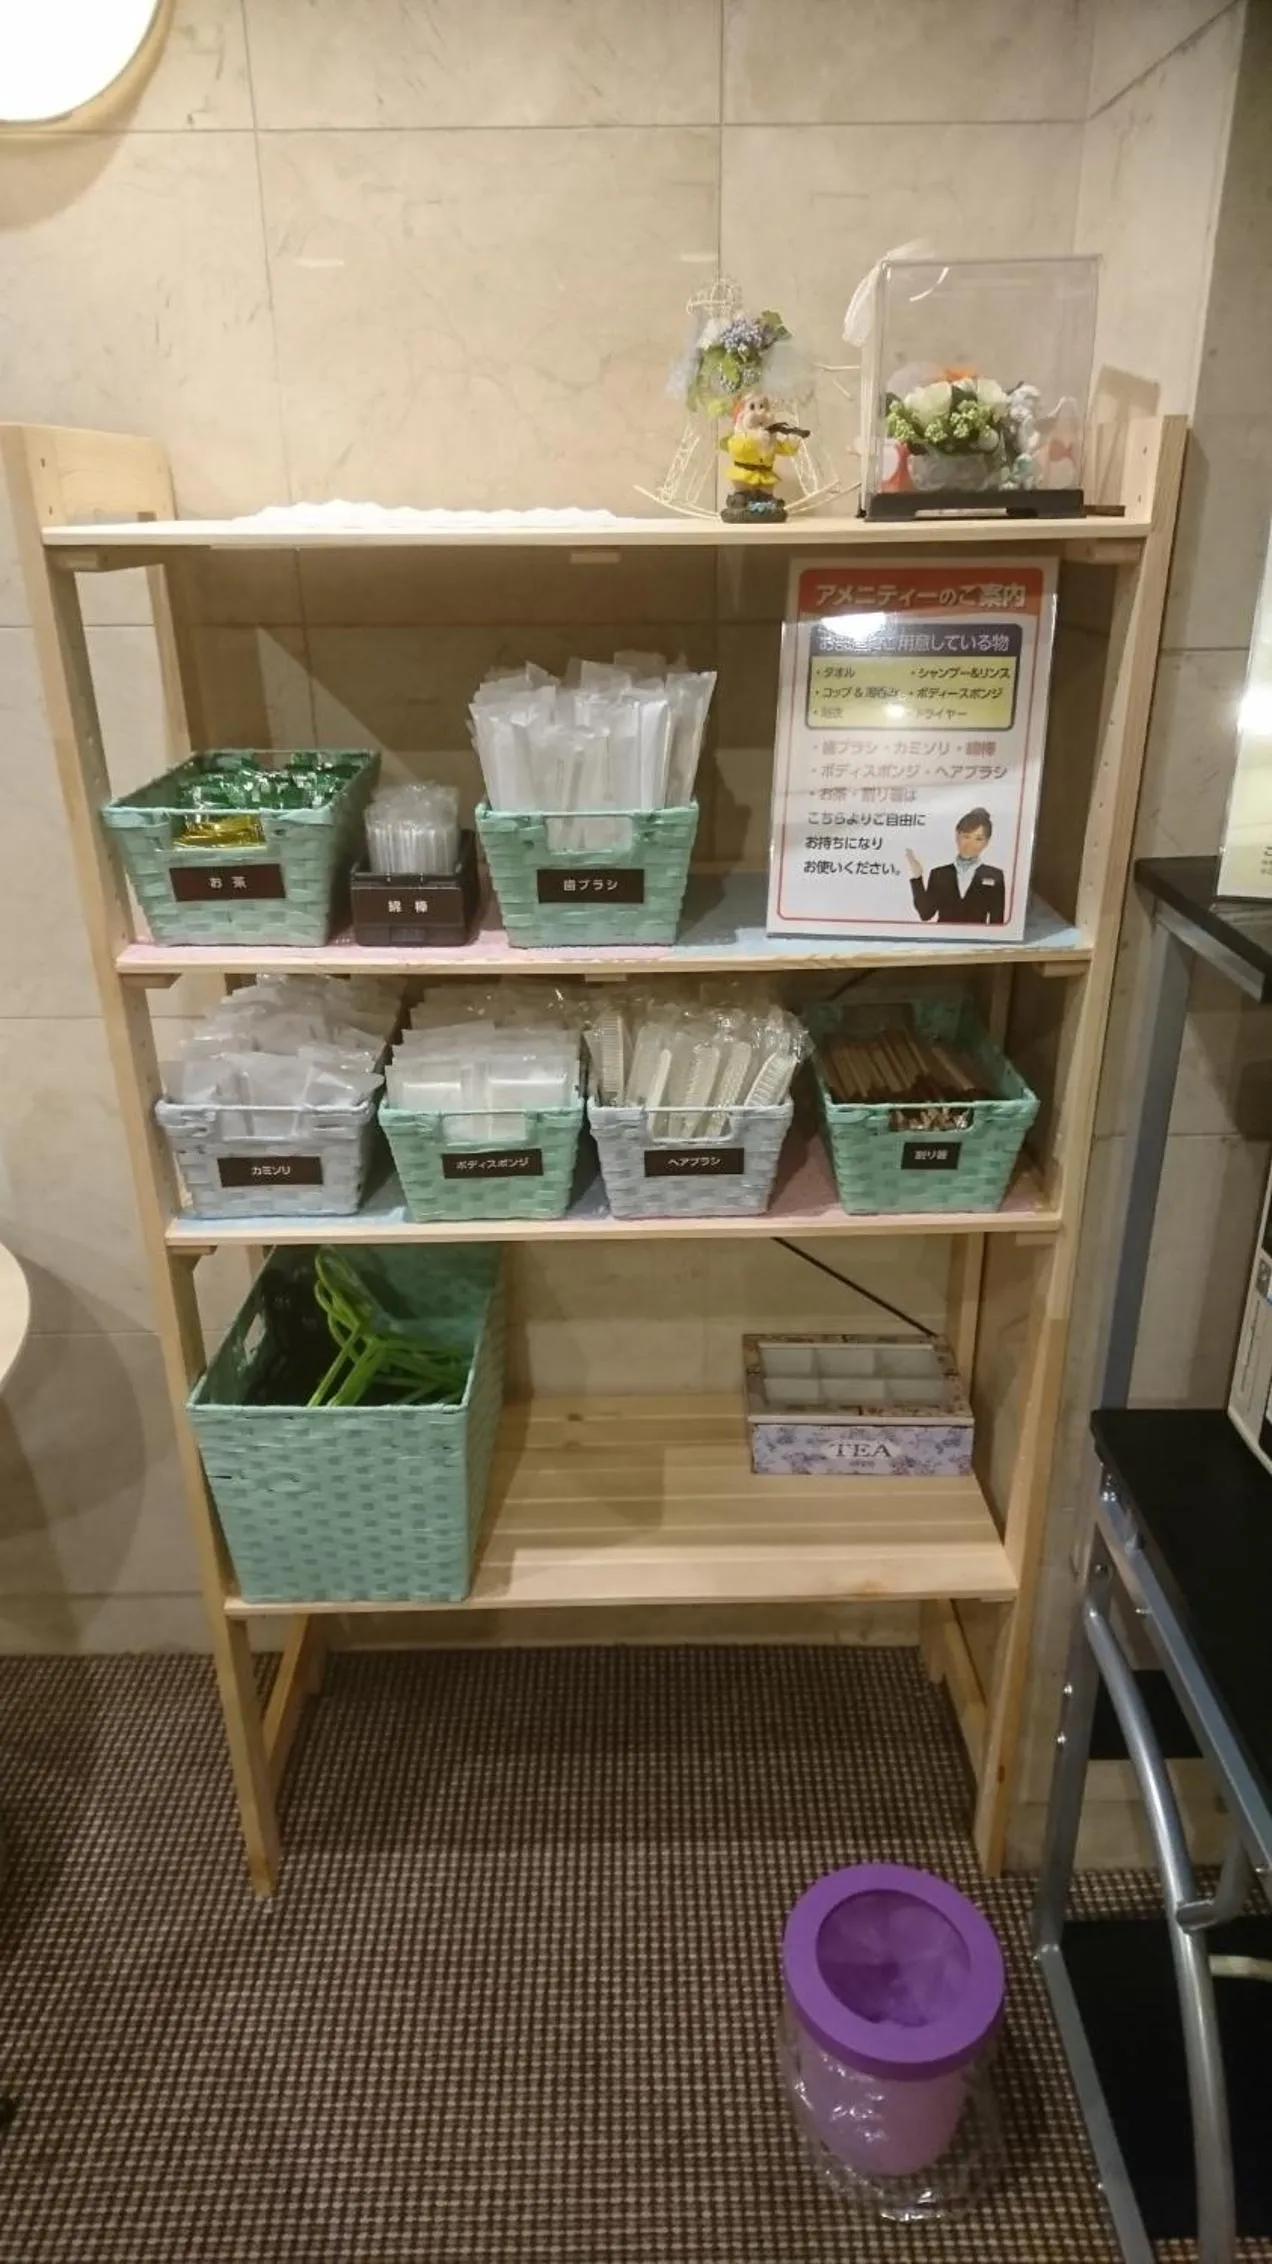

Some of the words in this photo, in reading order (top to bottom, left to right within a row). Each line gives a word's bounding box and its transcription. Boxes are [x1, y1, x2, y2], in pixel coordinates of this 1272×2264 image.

[816, 582, 1027, 608] アメニティーのご案内
[808, 811, 926, 827] こちらよりご自由に
[805, 836, 884, 851] お持ちになり
[803, 860, 902, 876] お使いください。
[563, 879, 619, 892] 歯ブラシ
[456, 1157, 530, 1170] ボディスポンジ
[667, 1156, 722, 1167] ヘアブラシ
[252, 1165, 292, 1177] カミソリ
[831, 1443, 892, 1458] TEA
